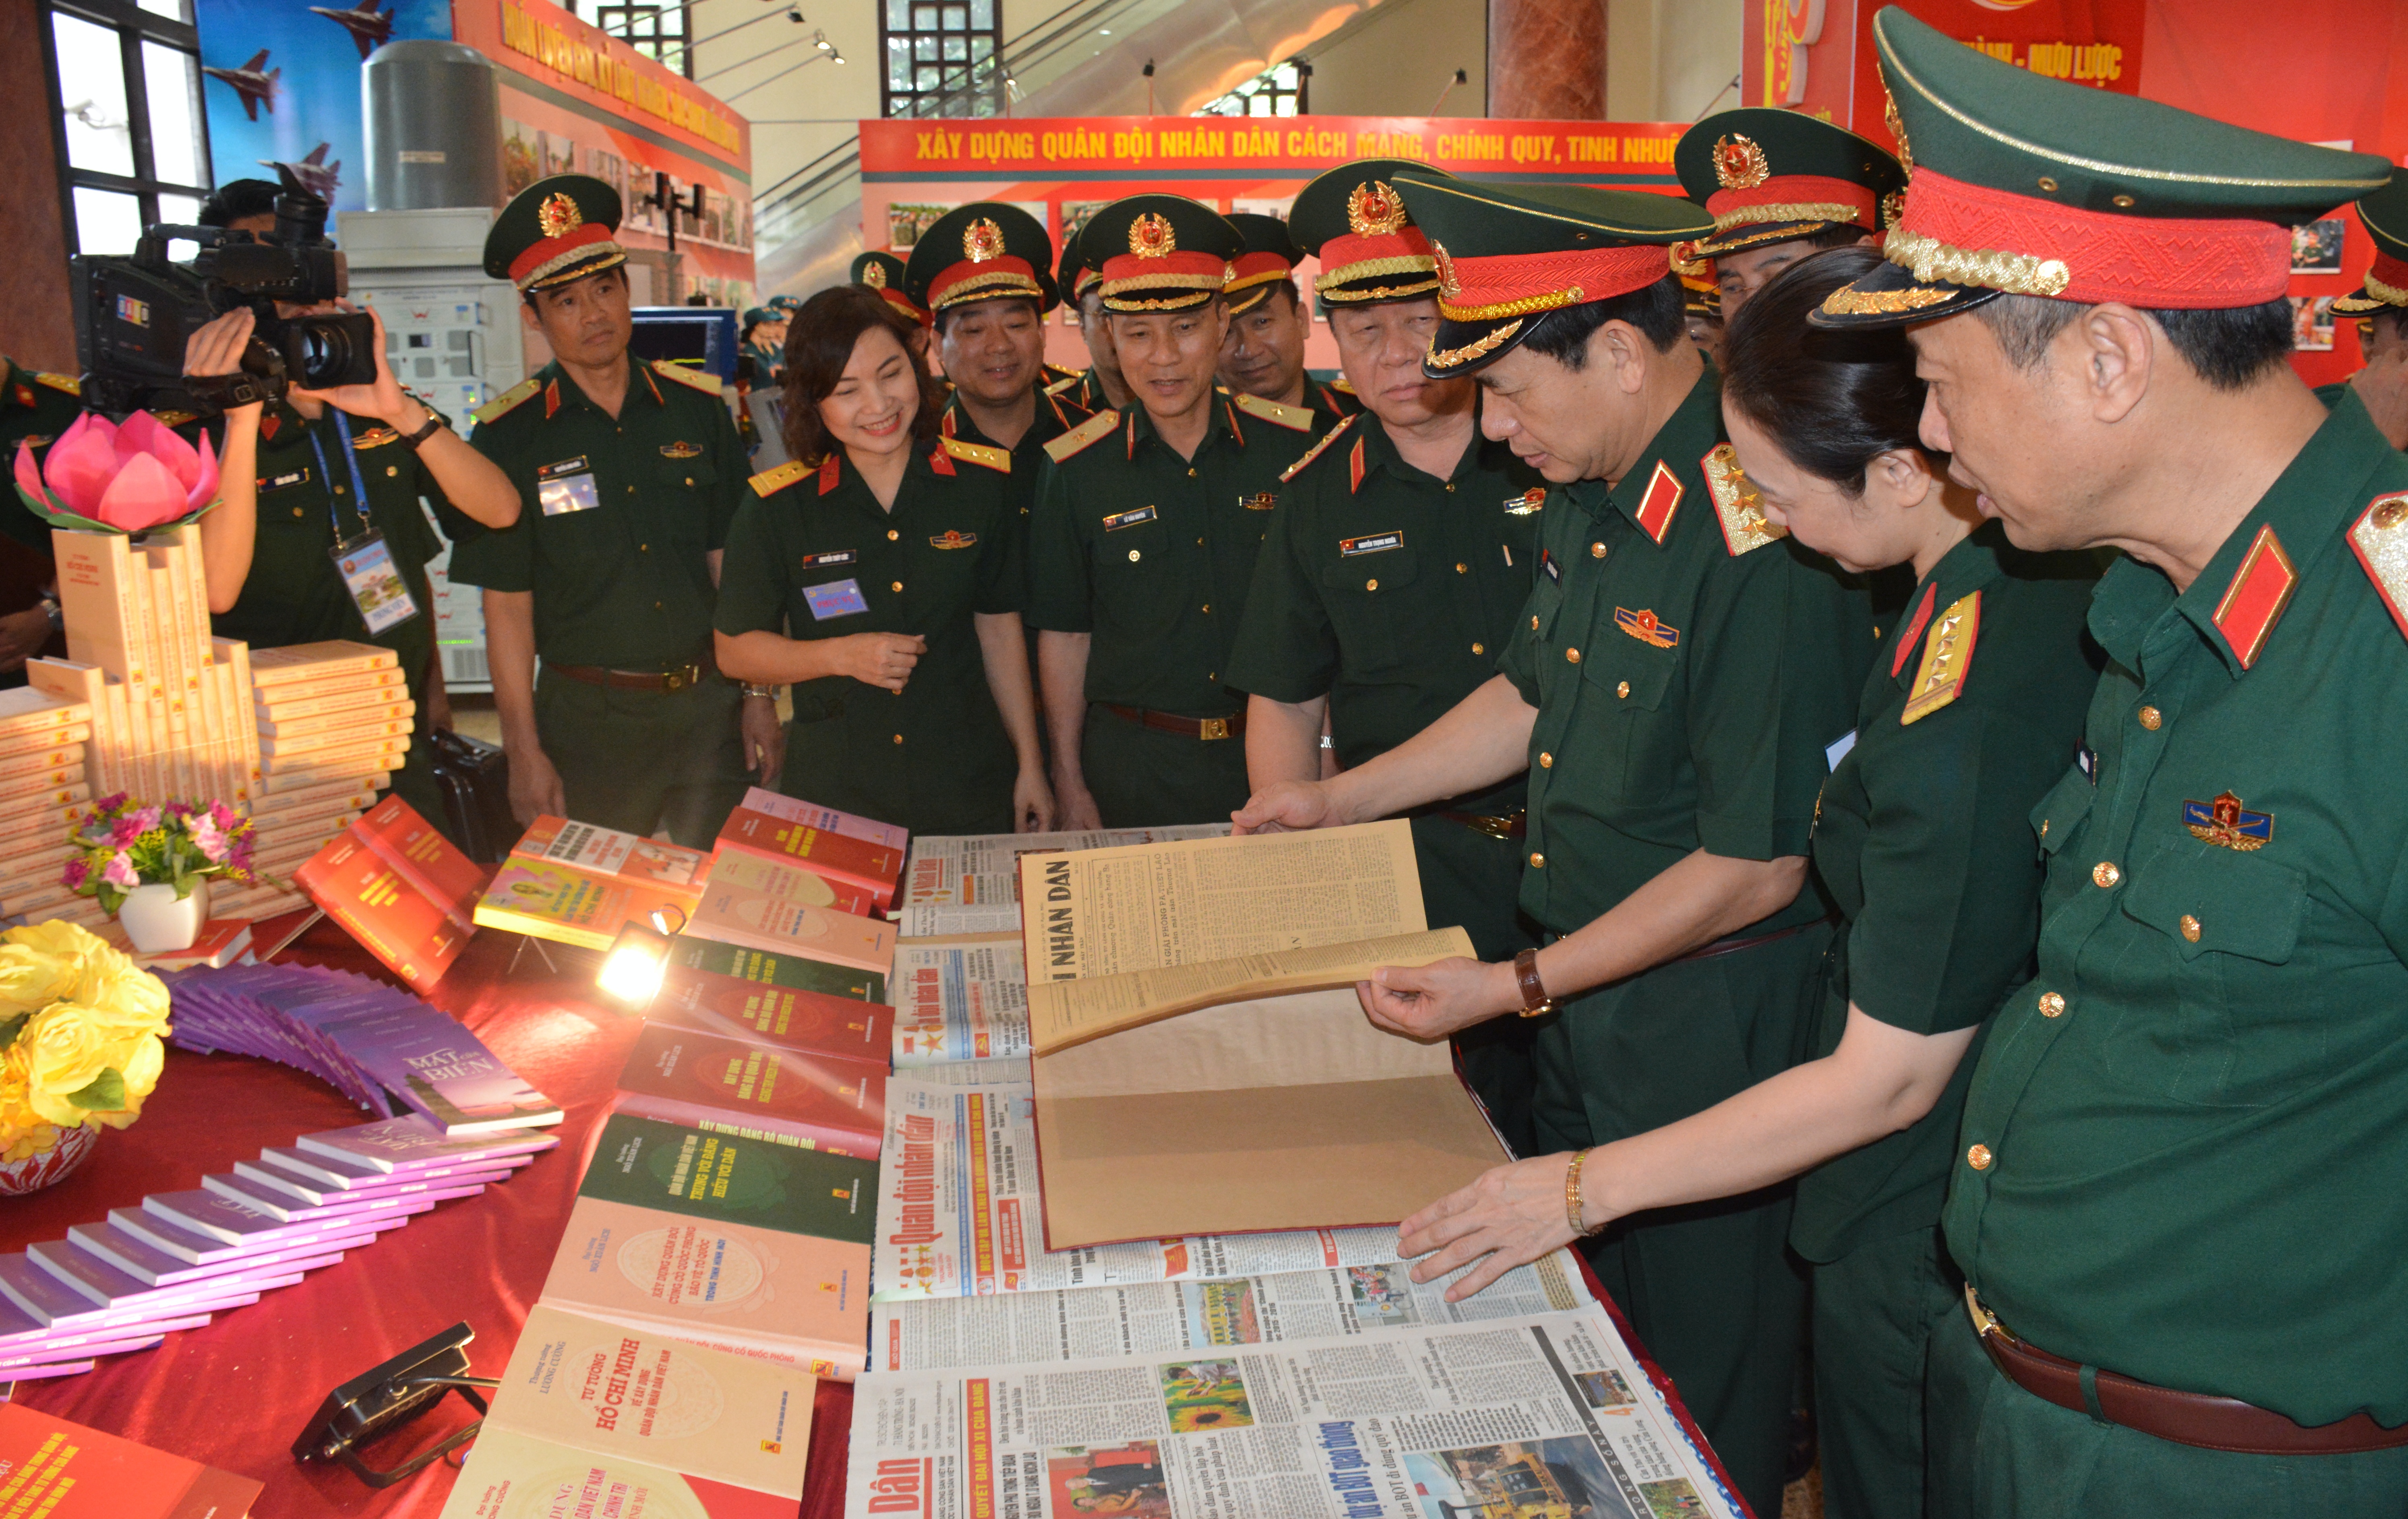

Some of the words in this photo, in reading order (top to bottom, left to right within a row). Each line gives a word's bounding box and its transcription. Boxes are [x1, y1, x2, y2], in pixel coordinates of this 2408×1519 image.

[2073, 43, 2122, 87] LƯỢC
[916, 128, 962, 159] XÂY
[970, 130, 1034, 163] DỰNG
[1042, 126, 1106, 159] QUÂN
[1114, 126, 1153, 163] ĐỘI
[1160, 125, 1225, 158] NHÂN
[1232, 126, 1280, 157] DÂN
[1287, 126, 1348, 158] CÁCH
[1437, 130, 1505, 161] CHÍNH
[1511, 135, 1562, 165] QUY,
[1568, 136, 1618, 163] TINH
[1045, 860, 1072, 902] DÂN
[1158, 907, 1169, 937] PHÓNG
[1047, 908, 1075, 966] NHÂN
[408, 1050, 459, 1069] MẮT
[699, 1118, 715, 1131] XÂY
[896, 1114, 934, 1141] dân
[698, 1137, 719, 1160] ĐẢNG
[718, 1147, 737, 1164] DÂN
[695, 1159, 713, 1172] VỚI
[894, 1143, 934, 1178] nhân
[715, 1164, 733, 1176] VỚI
[689, 1173, 709, 1199] TRUNG
[710, 1177, 729, 1198] HIẾU
[893, 1178, 939, 1202] đội
[976, 1192, 987, 1210] THEO
[665, 1226, 680, 1240] ĐỘI
[889, 1204, 943, 1245] Quân
[681, 1226, 697, 1250] PHÒNG
[660, 1240, 676, 1259] QUÂN
[695, 1239, 711, 1259] QUỐC
[674, 1250, 691, 1270] QUỐC
[693, 1260, 706, 1268] TỔ
[655, 1261, 671, 1281] DỰNG
[672, 1271, 685, 1282] CỐ
[691, 1270, 705, 1279] VỆ
[651, 1281, 665, 1297] XÂY
[667, 1283, 683, 1304] CỦNG
[687, 1280, 701, 1296] BẢO
[705, 1281, 718, 1301] TRONG
[1268, 1302, 1277, 1316] 2016
[1271, 1320, 1281, 1333] 2015
[546, 1341, 567, 1366] CƯỜNG
[619, 1338, 640, 1378] MINH
[658, 1350, 672, 1364] NAM
[712, 1341, 732, 1353] CỦNG
[734, 1344, 746, 1356] CỐ
[747, 1345, 768, 1359] QUỐC
[770, 1350, 794, 1364] PHÒNG
[528, 1362, 547, 1383] Thượng
[583, 1353, 607, 1385] TƯỞNG
[635, 1370, 652, 1385] DỰNG
[653, 1363, 671, 1376] VIỆT
[538, 1367, 557, 1394] LƯƠNG
[649, 1375, 665, 1389] DÂN
[580, 1386, 597, 1400] TƯ
[603, 1377, 628, 1406] CHÍ
[631, 1386, 647, 1398] XÂY
[644, 1389, 662, 1407] NHÂN
[970, 1383, 985, 1407] ĐẢNG
[628, 1398, 643, 1407] VỀ
[1603, 1407, 1635, 1416] 4
[592, 1406, 619, 1432] HỒ
[641, 1407, 659, 1418] ĐỘI
[971, 1409, 985, 1429] CỦA
[637, 1418, 655, 1436] QUÂN
[1364, 1418, 1386, 1432] đạo
[974, 1432, 985, 1441] XI
[1206, 1436, 1220, 1450] luật
[1314, 1422, 1358, 1448] thông
[1371, 1433, 1393, 1448] quỹ
[972, 1444, 988, 1460] HỘI
[1191, 1446, 1207, 1457] hội
[1209, 1450, 1226, 1467] pháp
[1325, 1449, 1371, 1470] giao
[1376, 1448, 1401, 1469] đúng
[974, 1463, 989, 1481] ĐẠI
[1194, 1457, 1210, 1469] lập
[584, 1468, 607, 1486] NAM
[1196, 1469, 1215, 1490] quyền
[1212, 1468, 1226, 1480] của
[1328, 1471, 1374, 1490] BOT
[1384, 1470, 1401, 1478] đi
[492, 1480, 512, 1503] CƯỜNG
[576, 1486, 602, 1502] VIỆT
[607, 1482, 633, 1494] TRỊ
[868, 1458, 920, 1513] Dân
[1215, 1482, 1233, 1497] định
[1388, 1480, 1410, 1500] BOT
[546, 1484, 578, 1519] DỰNG
[595, 1495, 628, 1518] CHÍNH
[973, 1484, 989, 1518] QUYẾT
[1201, 1491, 1216, 1507] đảm
[1223, 1499, 1236, 1513] quy
[1336, 1491, 1379, 1504] án
[1397, 1502, 1415, 1512] án
